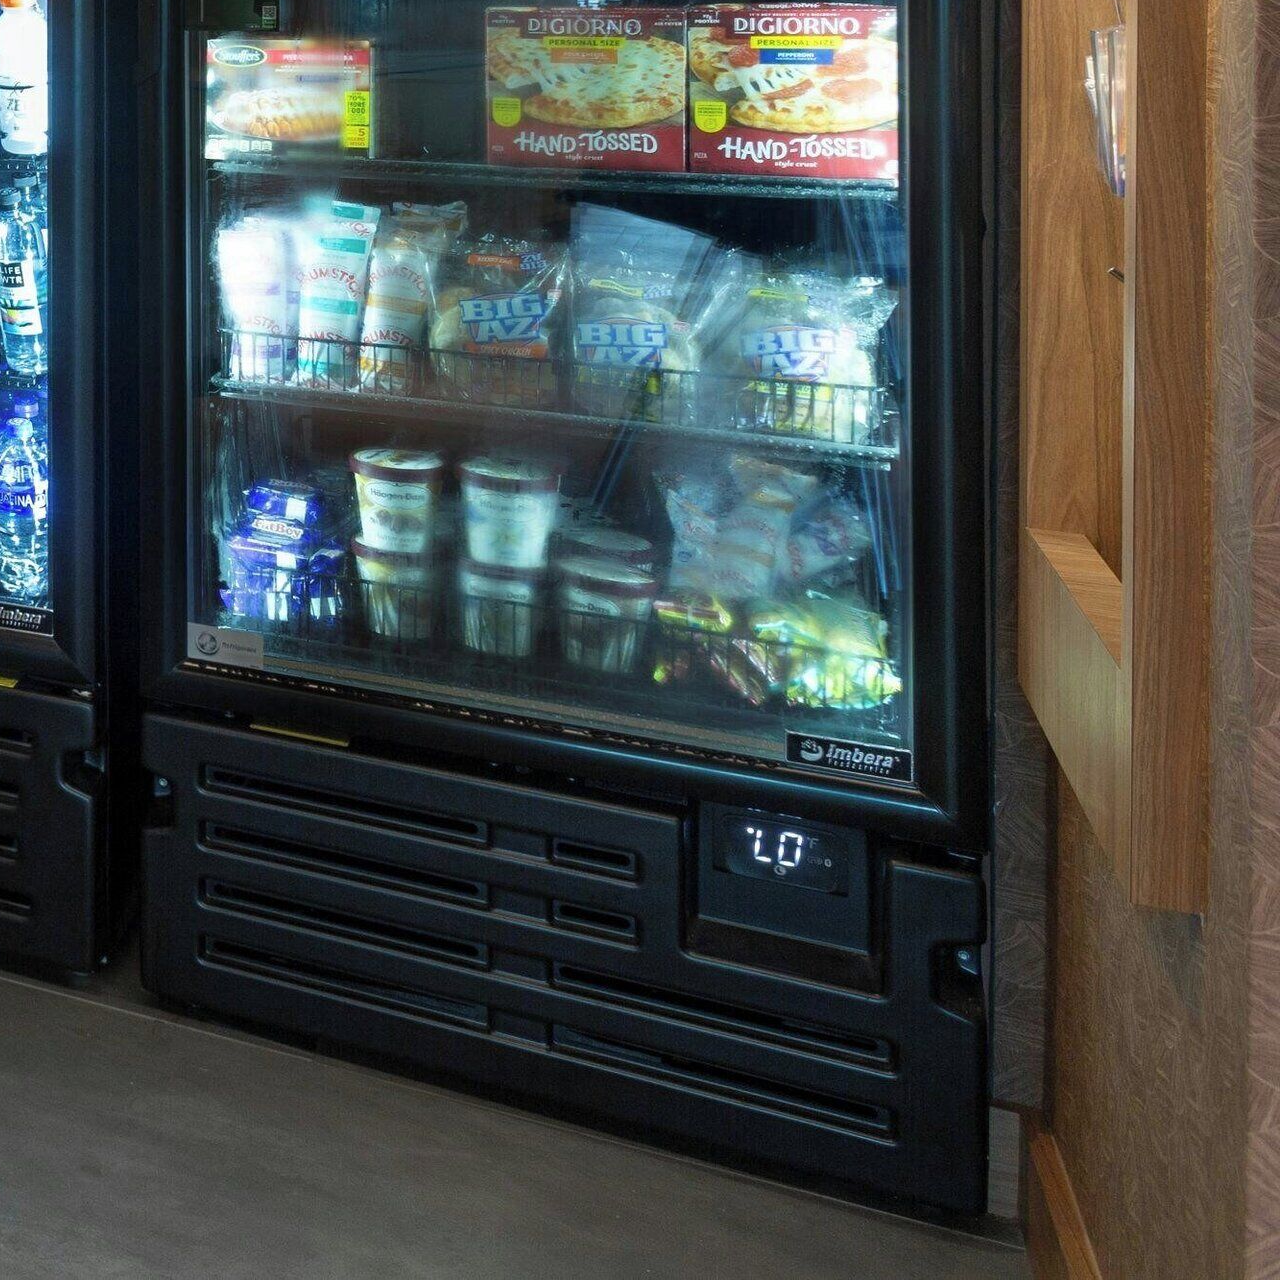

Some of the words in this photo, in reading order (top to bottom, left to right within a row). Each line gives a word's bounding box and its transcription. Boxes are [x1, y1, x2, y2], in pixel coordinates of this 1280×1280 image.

[548, 39, 597, 48] PERSONAL
[599, 39, 621, 48] SIZE
[757, 38, 809, 48] PERSONAL
[813, 38, 836, 48] SIZE
[513, 130, 658, 157] HAND-TOSSED
[717, 135, 876, 162] HAND-TOSSED
[775, 160, 794, 169] style
[0, 265, 22, 276] LIFE
[0, 275, 23, 285] WTR
[461, 294, 543, 322] BIG
[578, 323, 666, 347] BIG
[758, 330, 835, 354] BIG
[825, 743, 895, 770] Imbera
